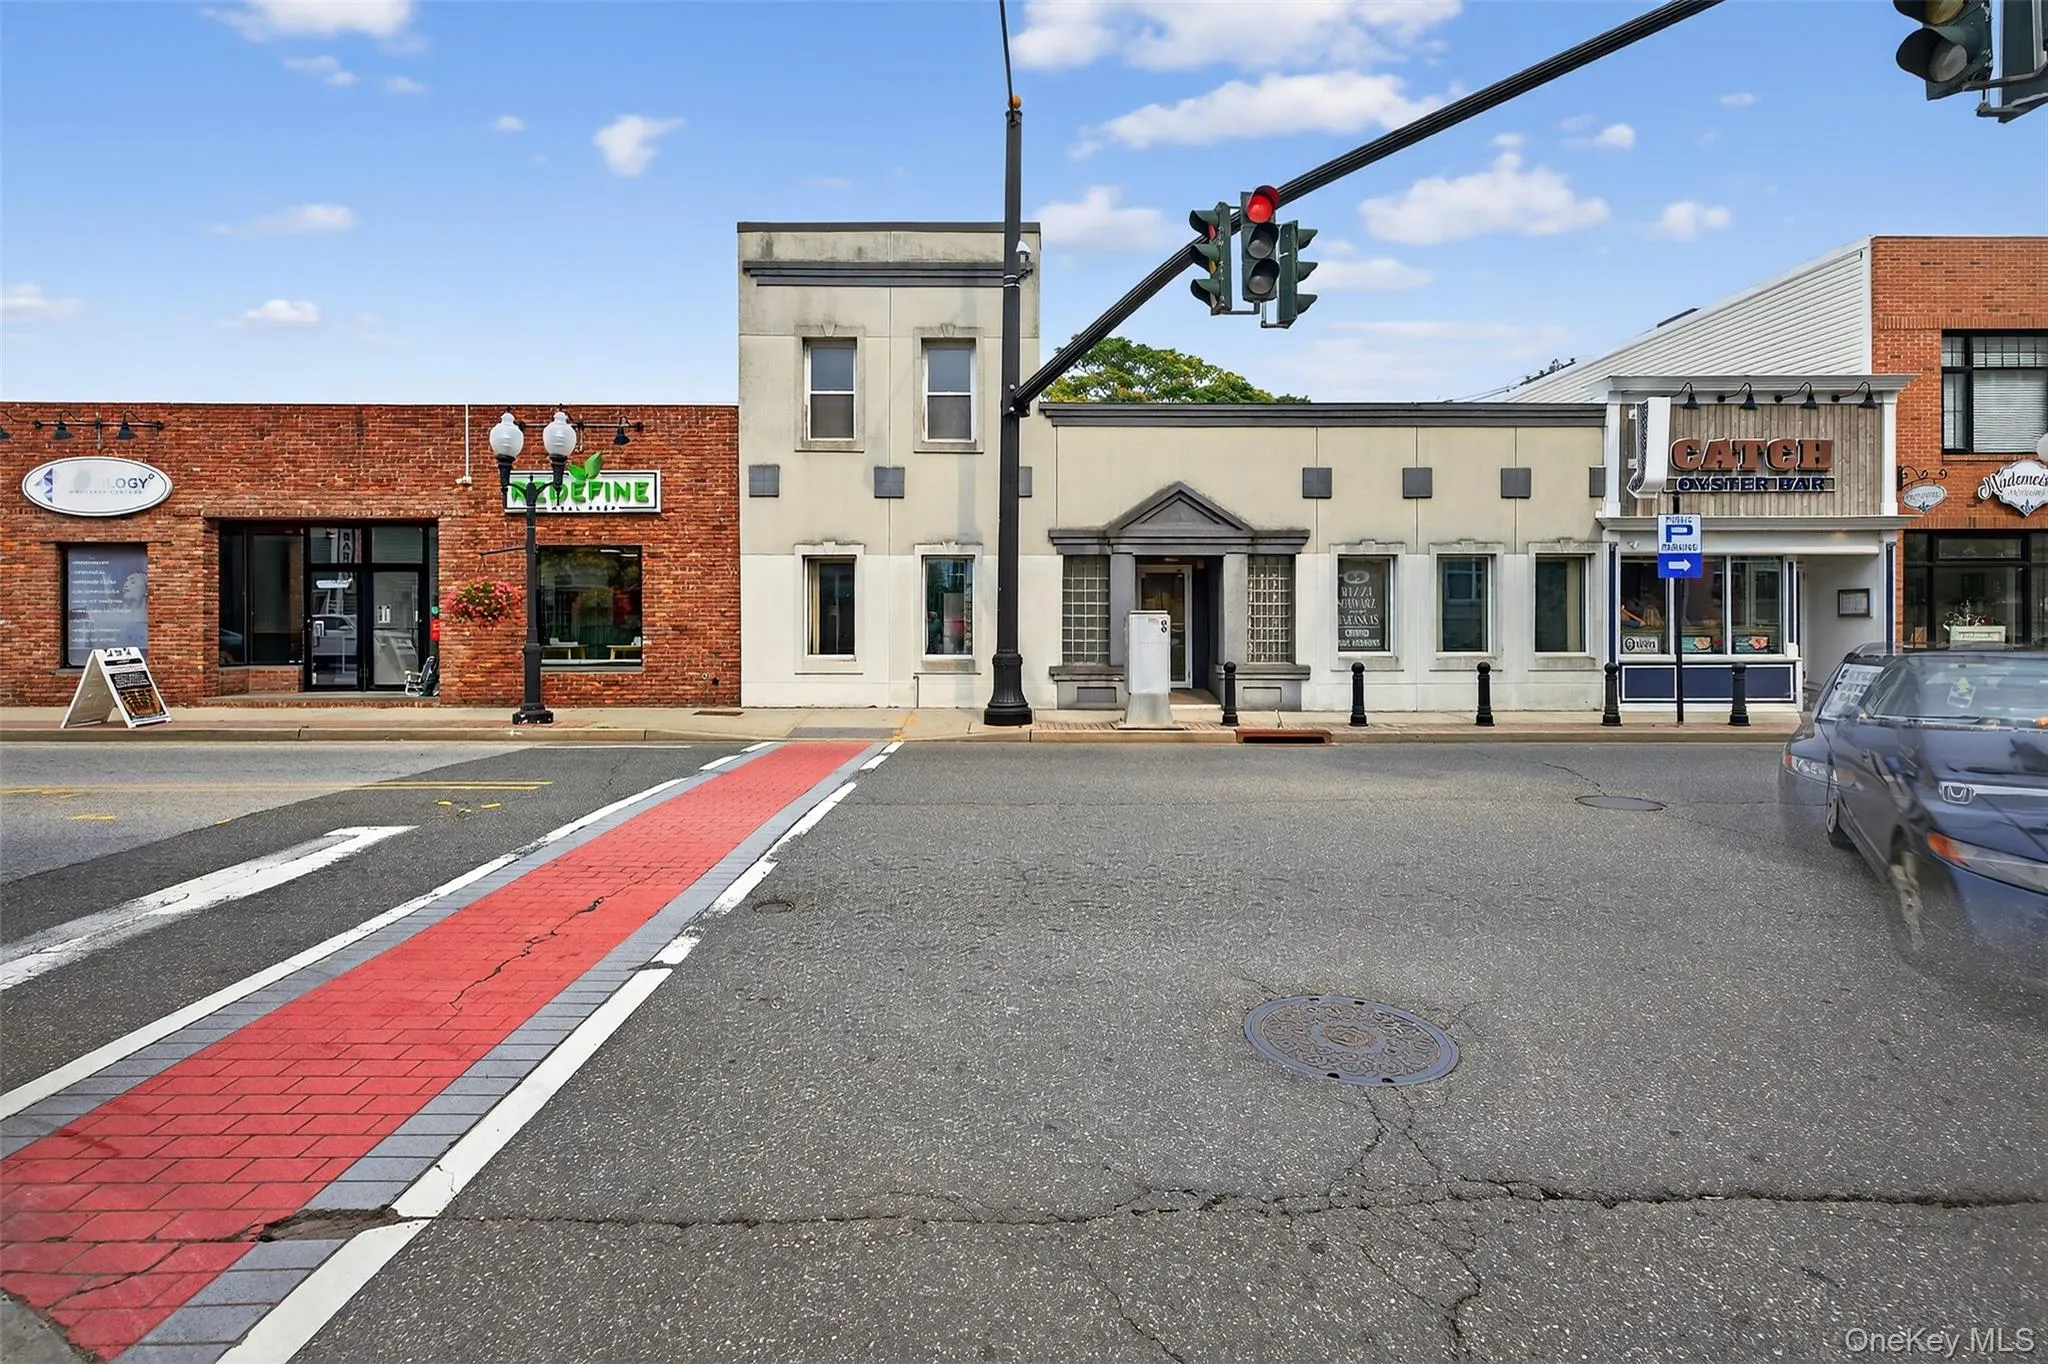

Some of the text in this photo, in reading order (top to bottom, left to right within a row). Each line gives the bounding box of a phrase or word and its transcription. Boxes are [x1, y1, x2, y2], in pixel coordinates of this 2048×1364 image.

[1670, 438, 1834, 472] CATCH
[1677, 477, 1824, 491] OYSTER BAR
